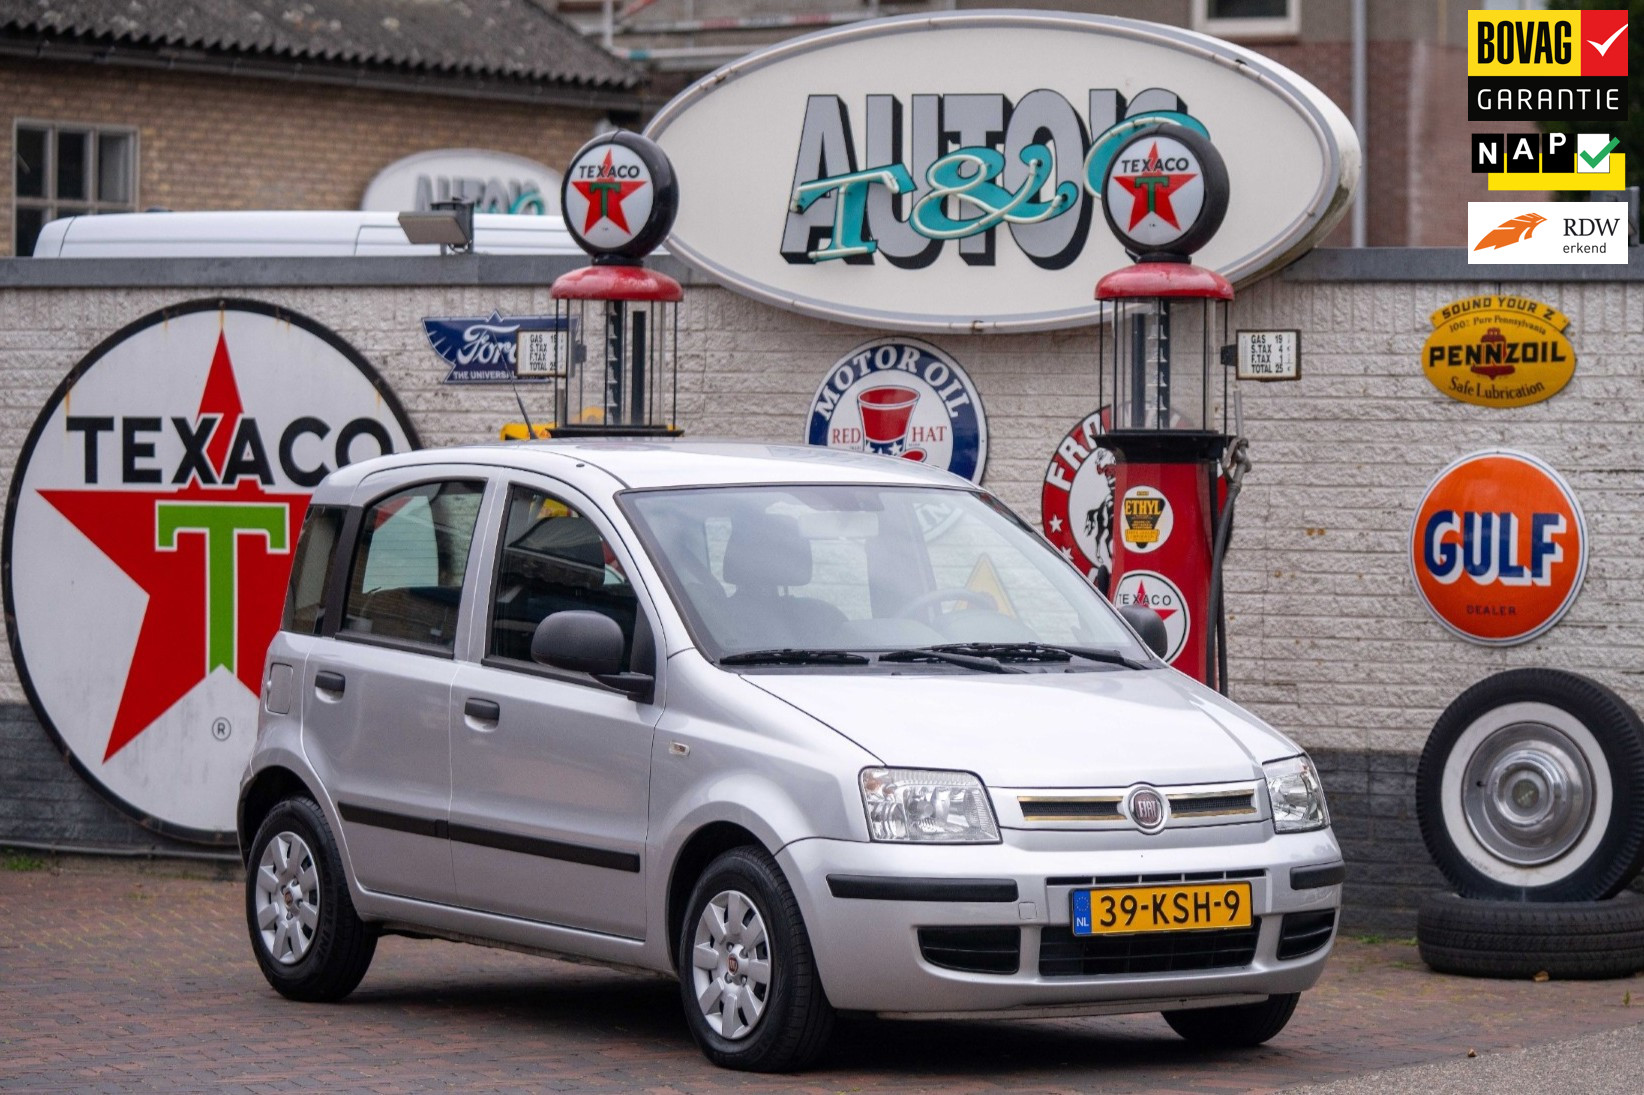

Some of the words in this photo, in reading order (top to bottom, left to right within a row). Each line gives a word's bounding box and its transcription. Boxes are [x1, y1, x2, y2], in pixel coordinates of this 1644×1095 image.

[579, 165, 640, 179] TEXACO
[1121, 158, 1189, 173] TEXACO
[1442, 297, 1492, 319] SOUND
[1498, 298, 1538, 313] YOUR
[1543, 309, 1556, 321] Z
[1473, 316, 1492, 325] Pure
[1494, 315, 1546, 336] Pennsylvania
[530, 334, 543, 343] GAS
[1251, 334, 1266, 344] GAS
[1251, 344, 1272, 354] S.TAX
[1429, 341, 1567, 368] PENNZOIL
[530, 362, 547, 370] TOTAL
[1251, 354, 1270, 364] F.TAX
[453, 370, 470, 380] THE
[1251, 364, 1272, 374] TOTAL
[1275, 364, 1284, 373] 25
[815, 346, 921, 421] MOTOR
[924, 362, 970, 418] OIL
[1449, 376, 1474, 395] Safe
[1476, 381, 1545, 400] Lubrication
[832, 427, 862, 444] RED
[912, 426, 947, 442] HAT
[1125, 500, 1161, 515] ETHYL
[1424, 509, 1567, 586] GULF
[1466, 604, 1516, 615] DEALER
[1138, 800, 1158, 819] FIAT
[1100, 890, 1240, 927] 39-KSH-9
[1076, 917, 1089, 927] NL
